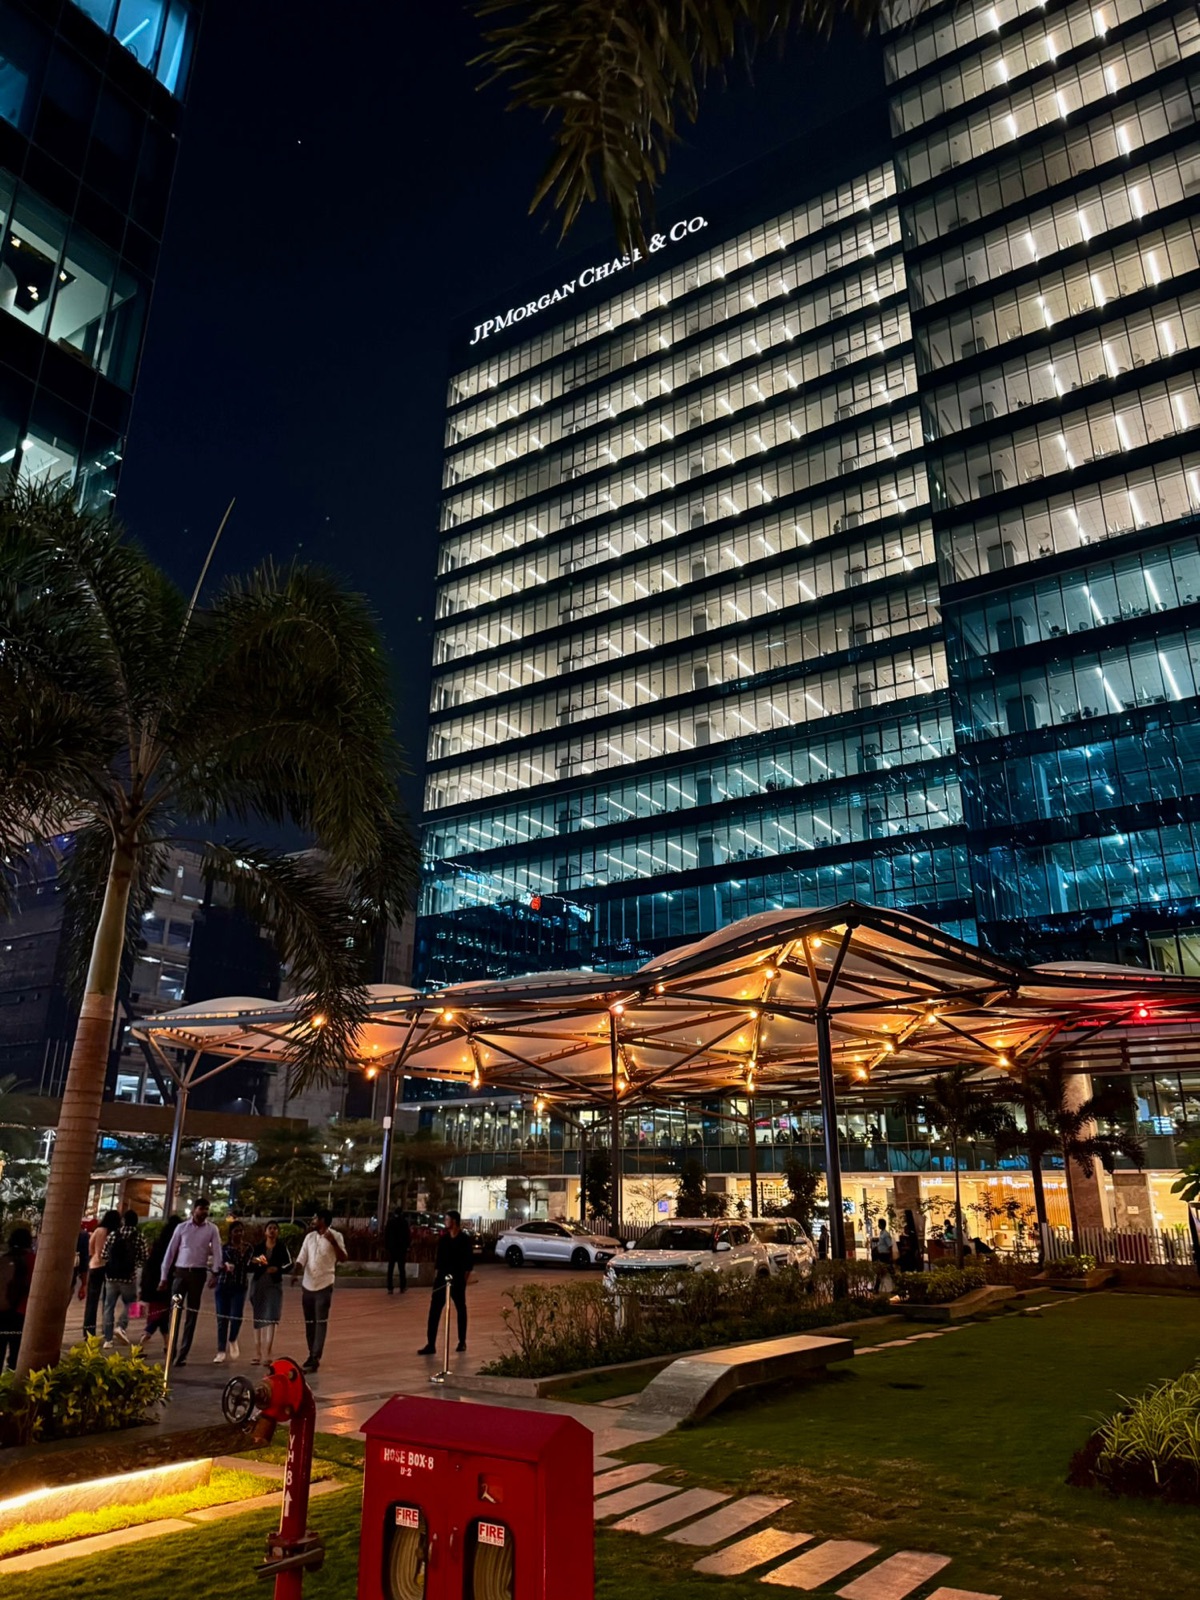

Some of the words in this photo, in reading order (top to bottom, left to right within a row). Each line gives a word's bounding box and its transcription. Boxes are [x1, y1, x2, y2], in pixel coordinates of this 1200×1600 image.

[648, 233, 668, 253] &
[383, 1447, 406, 1464] HOSE
[396, 1508, 418, 1522] FIRE
[479, 1523, 504, 1539] FIRE
